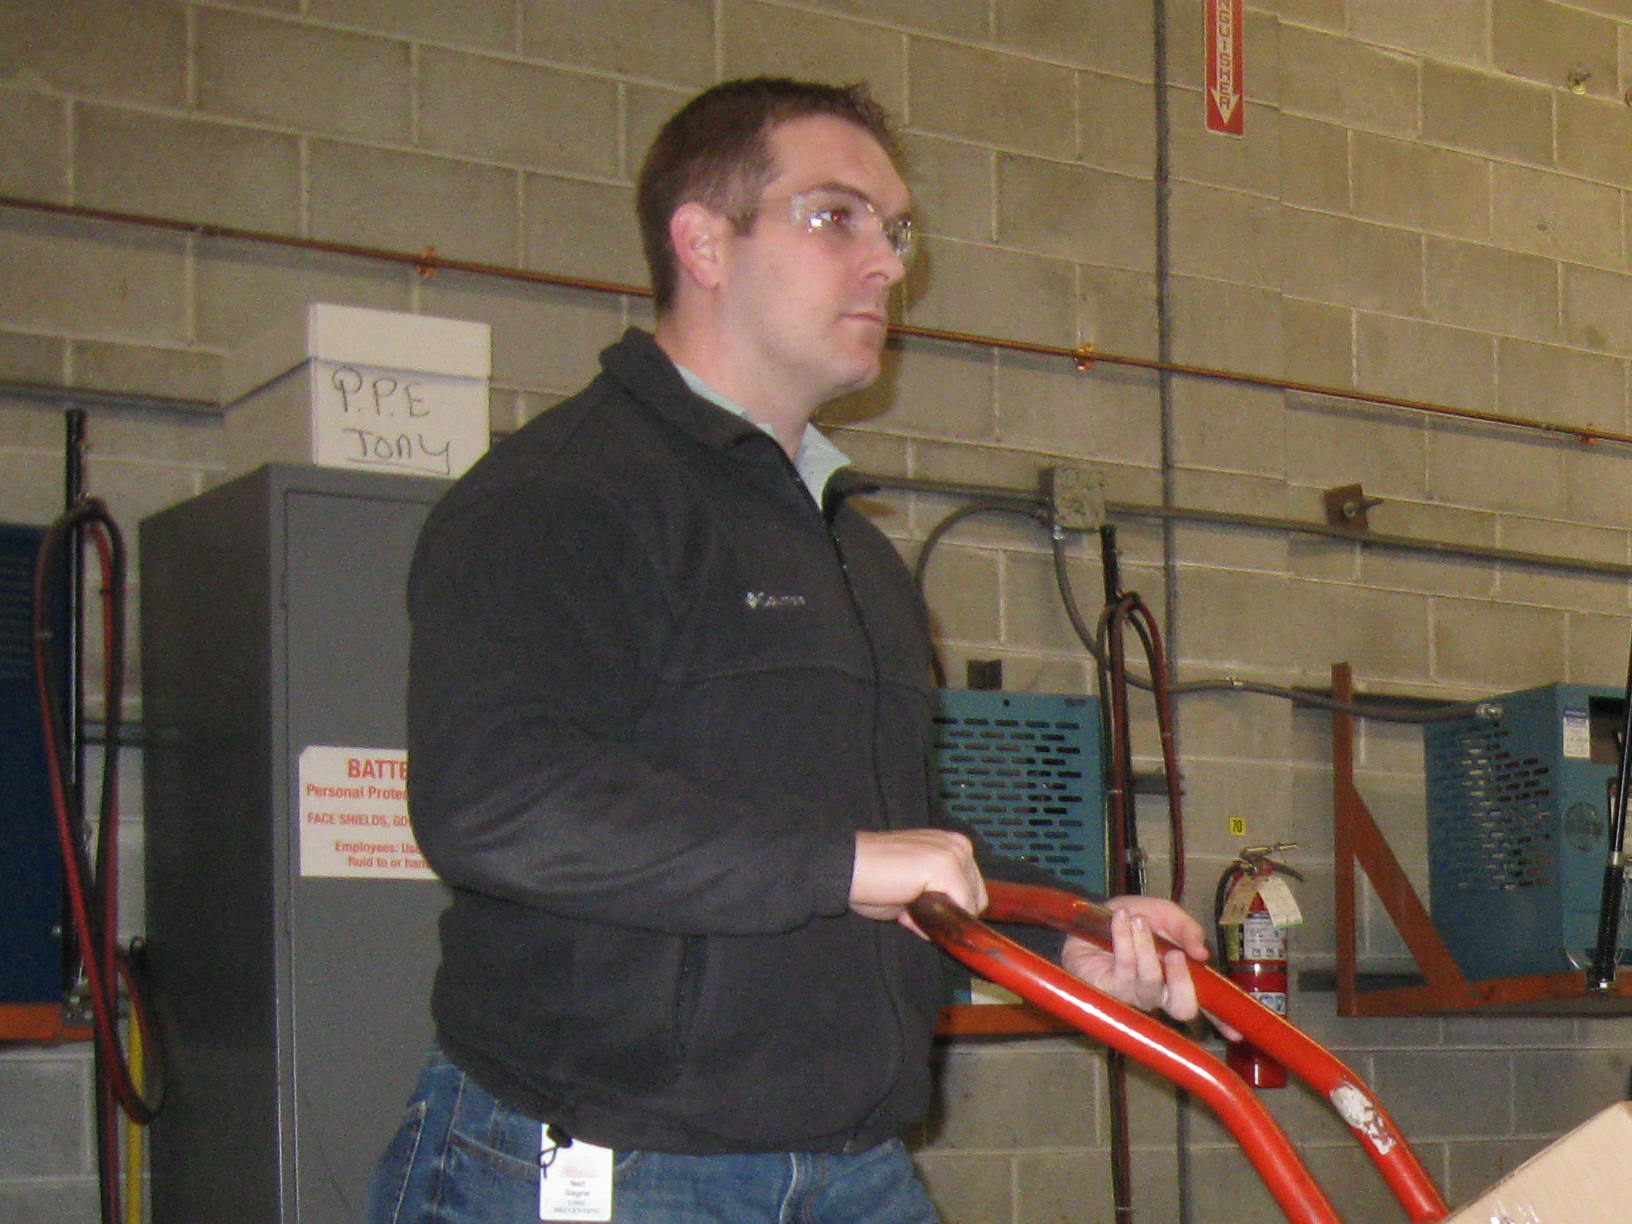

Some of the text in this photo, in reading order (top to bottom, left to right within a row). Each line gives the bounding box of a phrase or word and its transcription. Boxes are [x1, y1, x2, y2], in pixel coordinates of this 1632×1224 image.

[306, 783, 364, 799] Personal
[307, 812, 336, 825] FACE
[339, 813, 390, 828] SHIELDS,
[348, 856, 373, 868] fluid
[377, 857, 389, 868] to
[391, 859, 401, 869] or
